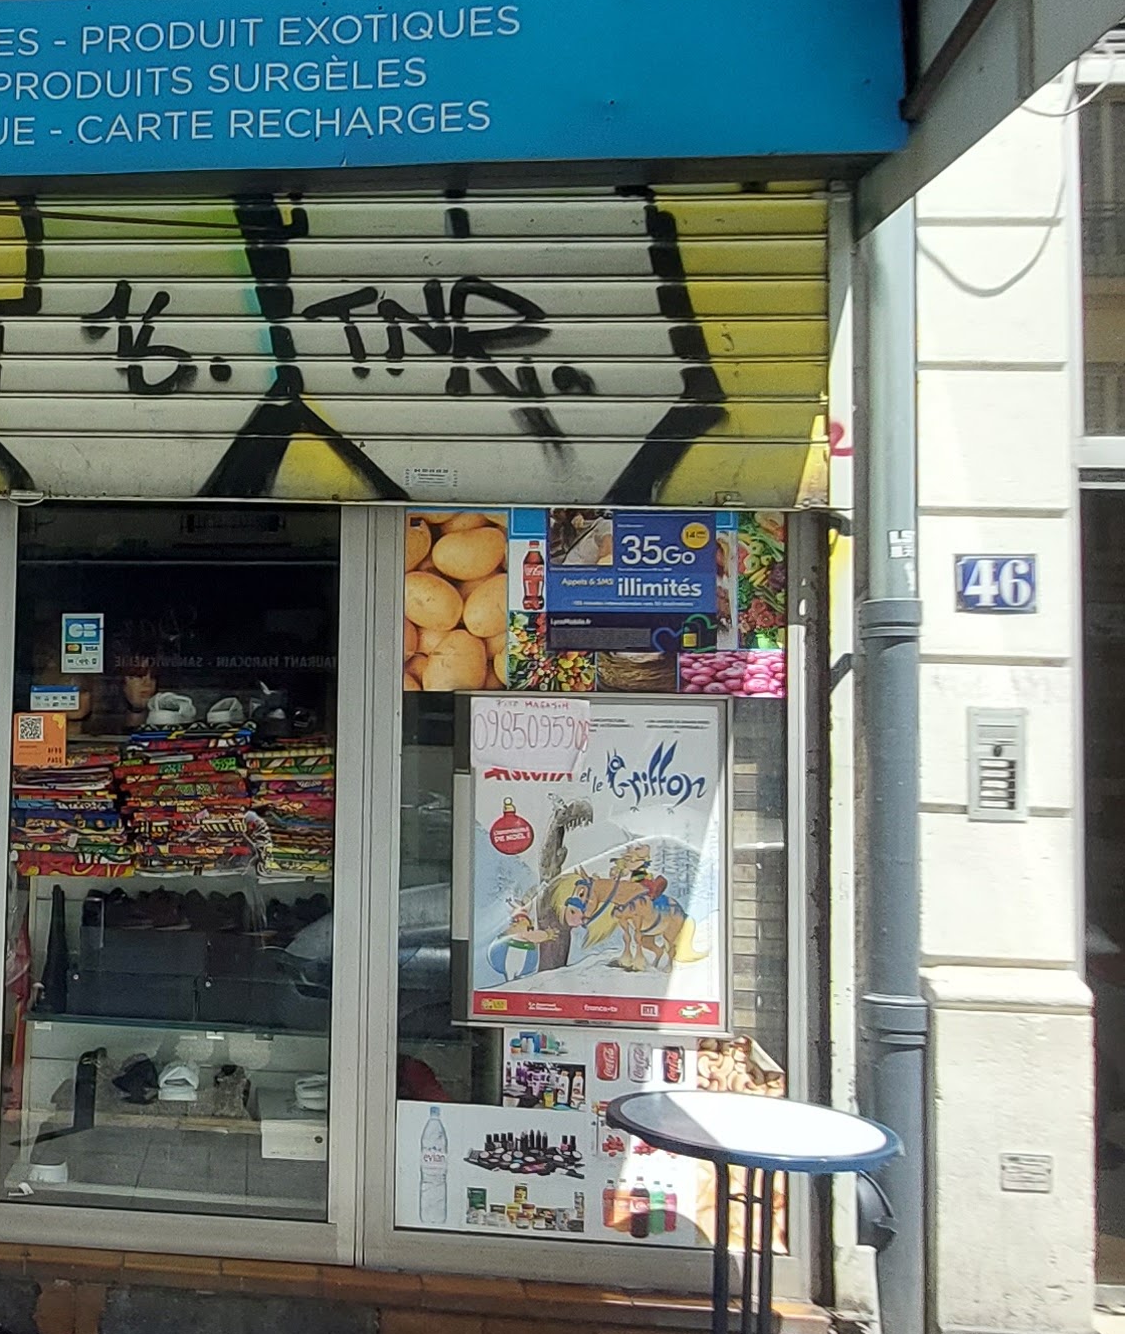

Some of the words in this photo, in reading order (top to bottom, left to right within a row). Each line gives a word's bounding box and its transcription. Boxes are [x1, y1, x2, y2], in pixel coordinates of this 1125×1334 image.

[80, 17, 264, 55] PRODUIT
[278, 5, 521, 48] EXOTIQUES
[207, 53, 429, 95] SURGÈLES
[76, 109, 214, 145] CARTE
[229, 100, 492, 140] RECHARGES
[620, 535, 696, 565] 35Go
[617, 577, 703, 597] illimités
[963, 559, 1032, 607] 46
[579, 767, 592, 783] et
[592, 776, 604, 794] le
[606, 739, 708, 807] Griffon
